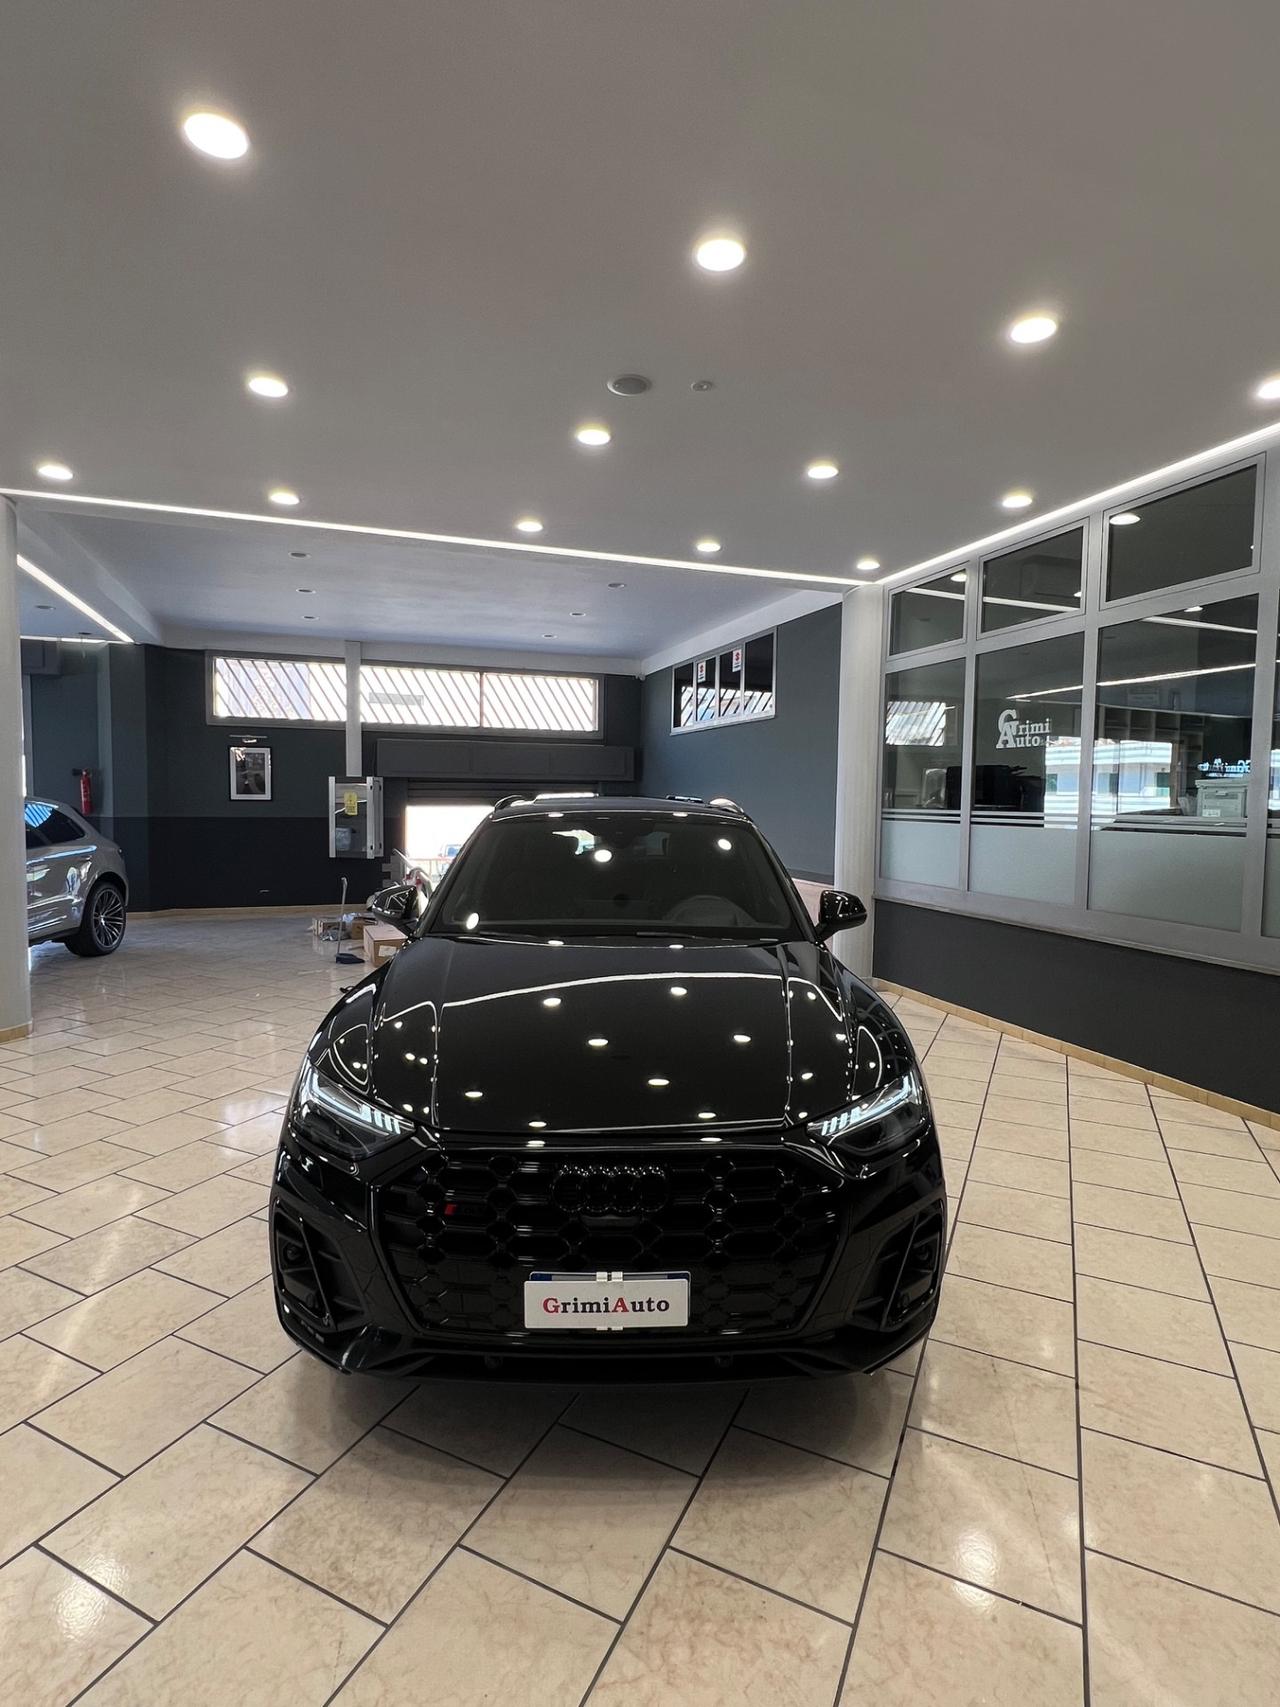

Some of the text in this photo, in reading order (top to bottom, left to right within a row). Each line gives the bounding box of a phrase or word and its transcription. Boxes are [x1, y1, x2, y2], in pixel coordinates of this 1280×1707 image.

[998, 709, 1051, 735] Grimi
[996, 722, 1041, 749] Auto
[542, 1296, 670, 1314] GrimiAuto
